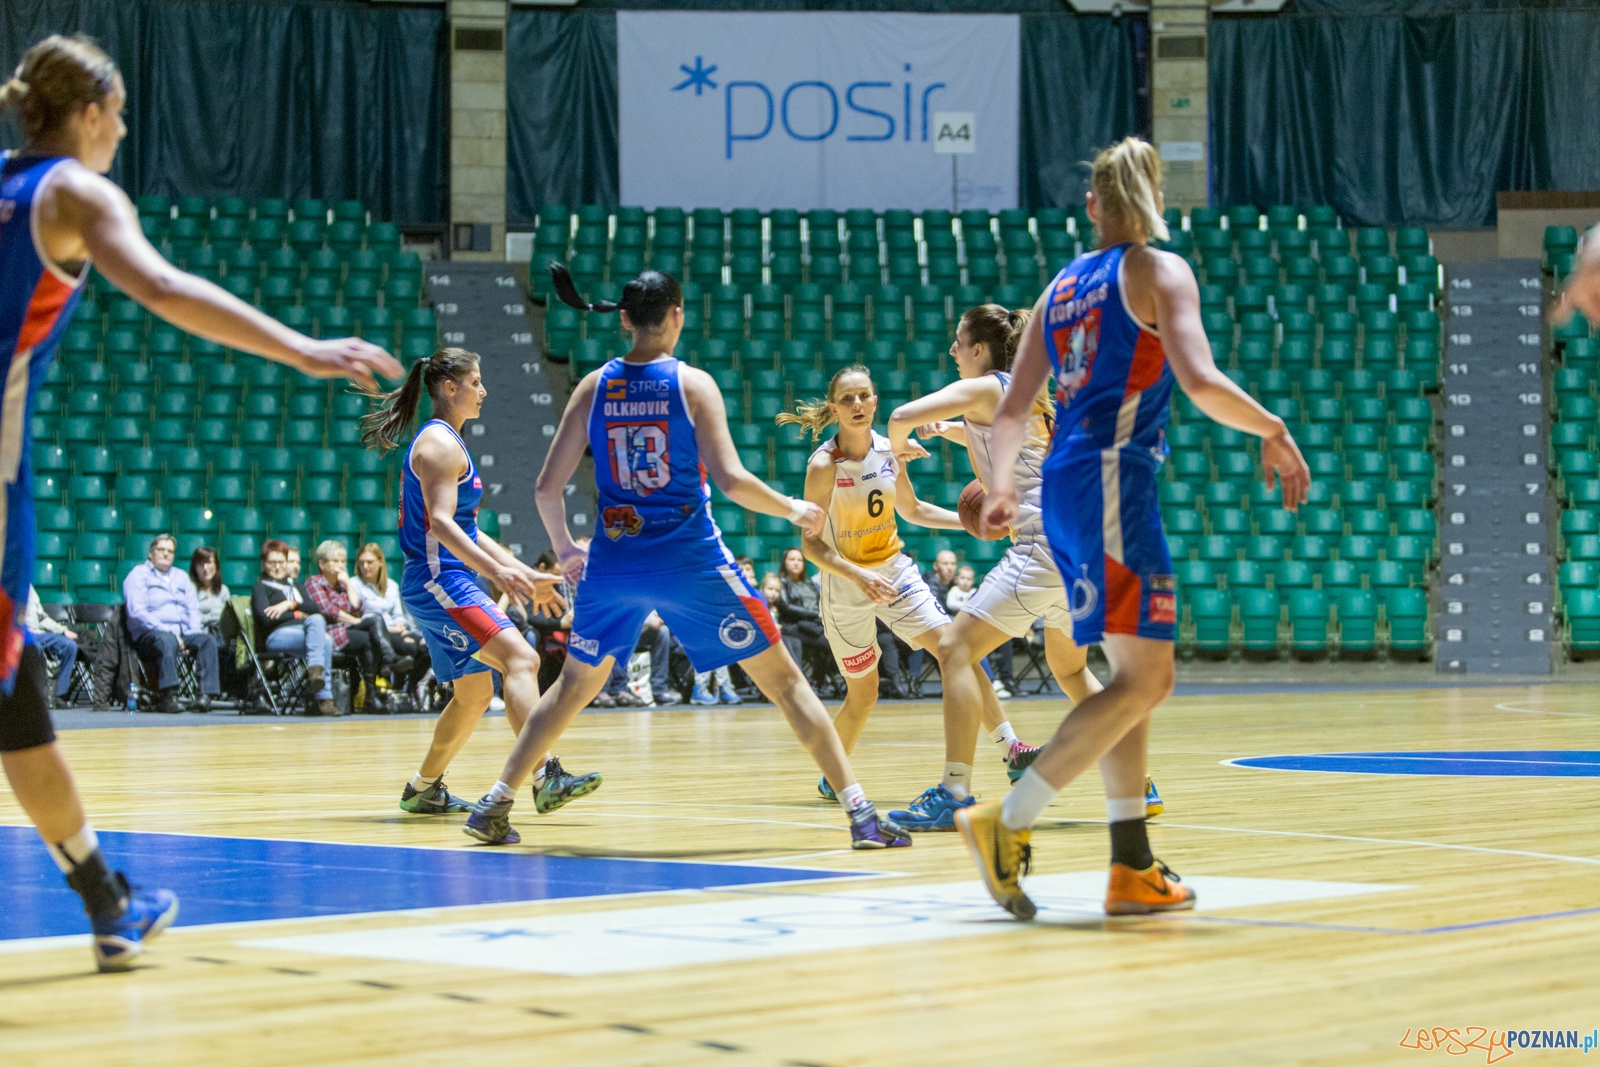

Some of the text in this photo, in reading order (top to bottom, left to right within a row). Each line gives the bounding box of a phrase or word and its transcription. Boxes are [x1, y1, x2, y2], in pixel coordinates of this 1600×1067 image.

[937, 123, 971, 141] A4
[429, 275, 451, 286] 14
[495, 276, 516, 288] 14
[1451, 278, 1472, 289] 14
[1519, 277, 1541, 289] 14
[521, 362, 540, 374] 11
[1449, 363, 1468, 375] 11
[1518, 362, 1537, 374] 11
[628, 378, 670, 393] STRUS
[530, 393, 552, 405] 10
[1448, 393, 1472, 406] 10
[1518, 393, 1542, 405] 10
[603, 400, 670, 416] OLKHOVIK
[606, 424, 672, 492] 13
[489, 483, 503, 496] 7
[1452, 484, 1466, 496] 7
[1525, 482, 1539, 495] 7
[867, 488, 885, 518] 6
[1448, 573, 1464, 586] 4
[1526, 572, 1542, 585] 4
[1448, 601, 1463, 615] 3
[1528, 601, 1544, 614] 3
[843, 648, 875, 667] TAURON
